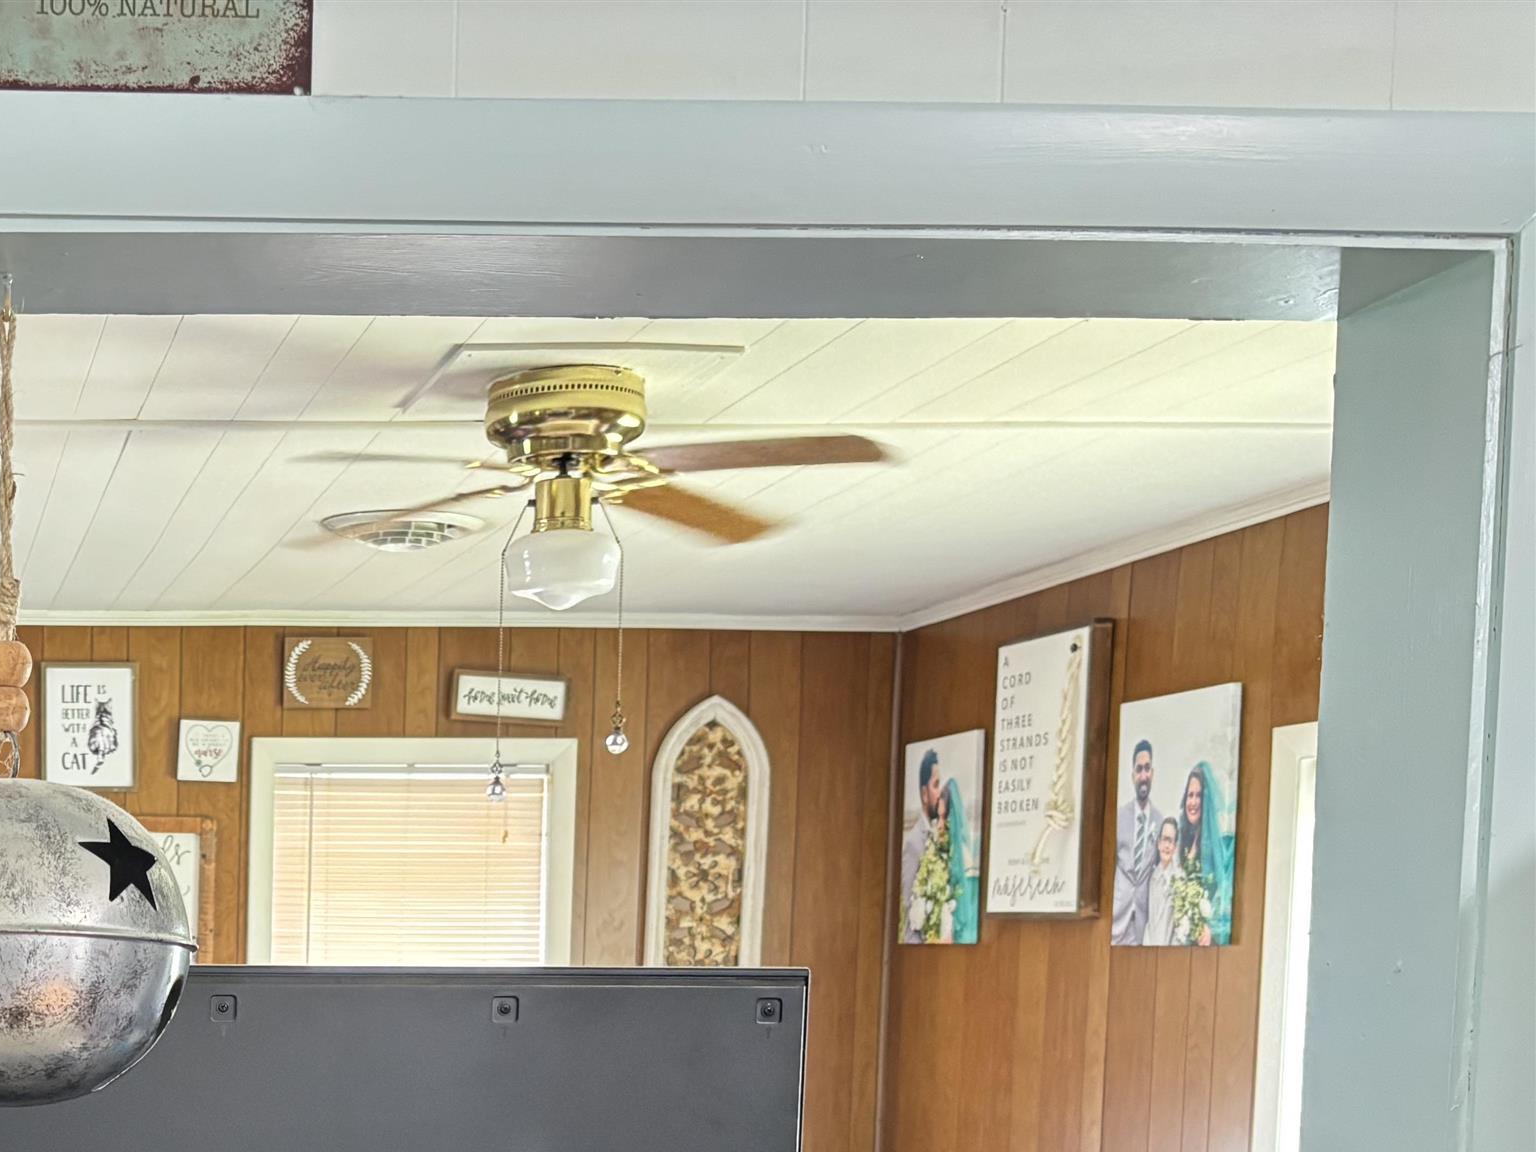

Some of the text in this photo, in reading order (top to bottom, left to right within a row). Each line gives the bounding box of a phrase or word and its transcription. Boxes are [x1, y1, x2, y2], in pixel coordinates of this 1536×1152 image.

[111, 0, 260, 19] NATURAL
[1002, 655, 1010, 668] A
[1001, 671, 1032, 690] CORD
[61, 684, 107, 704] LIFE IS
[1001, 694, 1015, 711] OF
[62, 708, 90, 720] BETTER
[1000, 713, 1033, 731] THREE
[62, 723, 86, 733] WITH
[70, 737, 79, 748] A
[999, 732, 1050, 753] STRANDS
[61, 752, 89, 770] CAT
[998, 755, 1035, 773] IS NOT
[997, 777, 1032, 795] EASILY
[996, 797, 1040, 816] BROKEN
